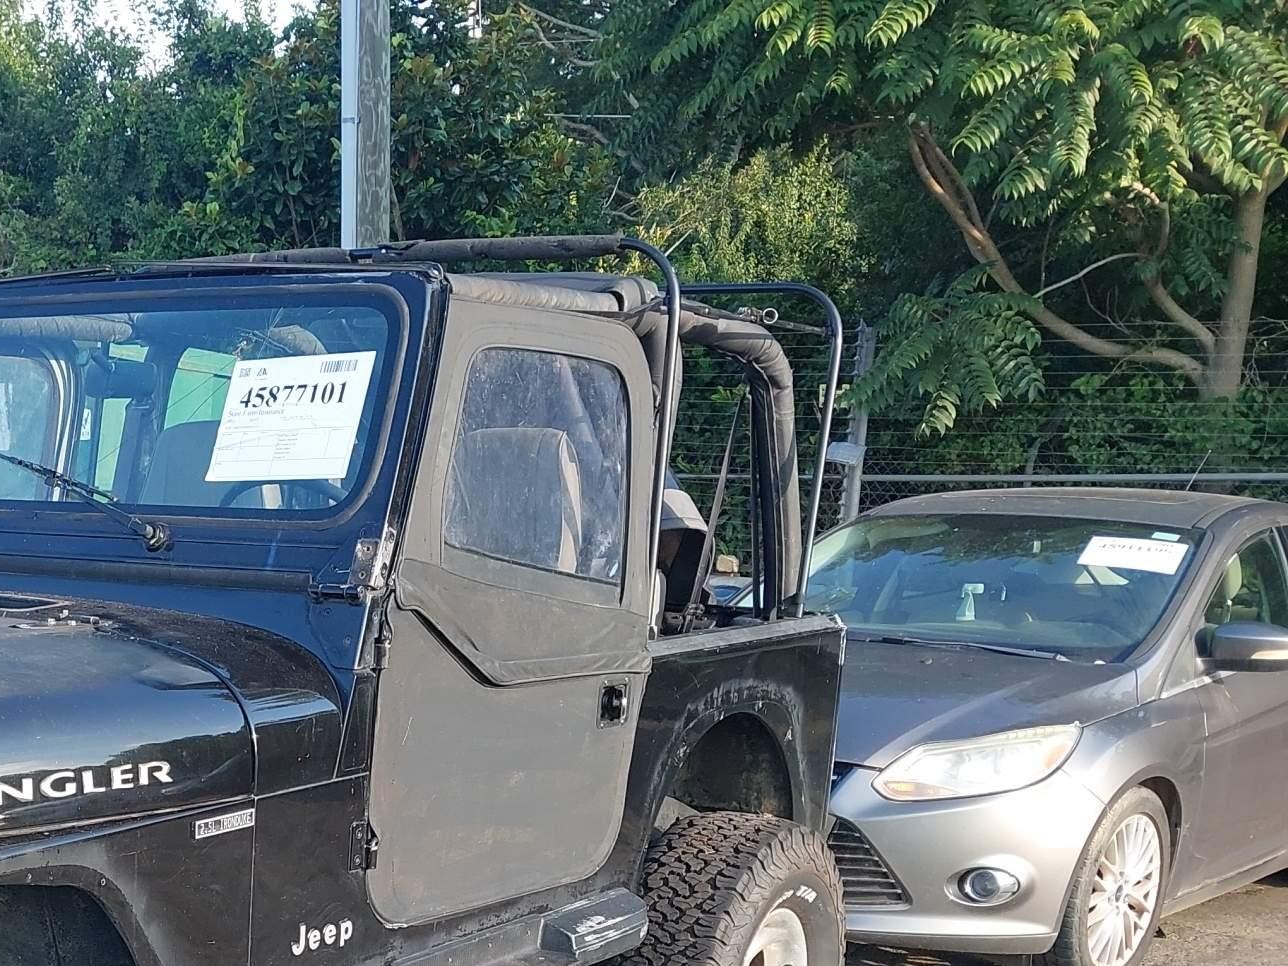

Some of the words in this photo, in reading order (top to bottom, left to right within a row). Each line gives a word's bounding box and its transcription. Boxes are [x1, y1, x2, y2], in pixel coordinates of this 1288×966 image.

[240, 382, 347, 408] 45877101
[795, 884, 818, 904] T/A
[290, 916, 354, 957] Jeep
